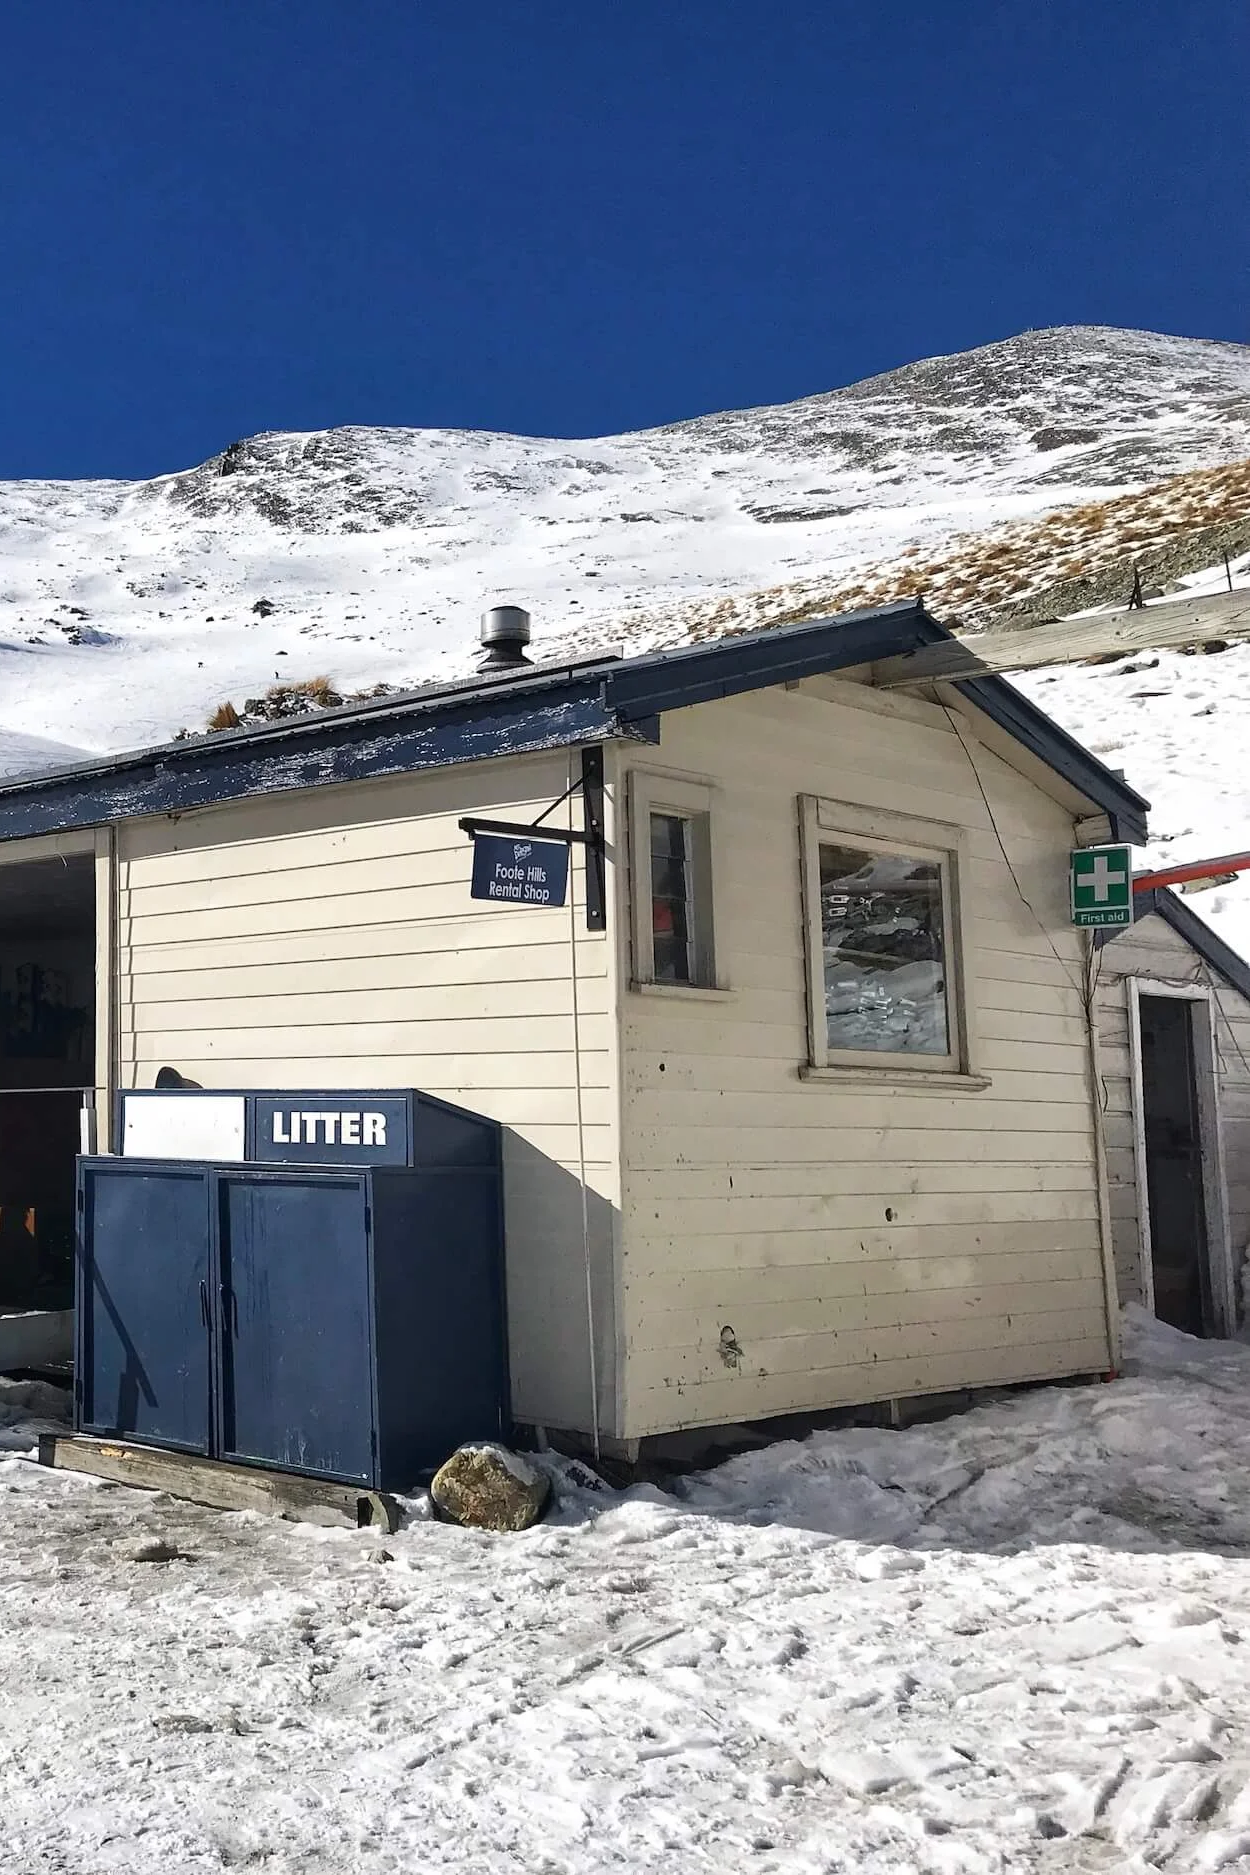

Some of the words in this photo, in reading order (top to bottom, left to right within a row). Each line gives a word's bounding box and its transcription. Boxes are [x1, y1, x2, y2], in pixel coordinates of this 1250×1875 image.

[495, 864, 524, 881] Foote
[527, 866, 547, 883] Hills
[489, 881, 522, 898] Rental
[524, 884, 550, 904] Shop
[1081, 913, 1104, 924] First
[1108, 911, 1124, 921] aid
[273, 1111, 387, 1146] LITTER
